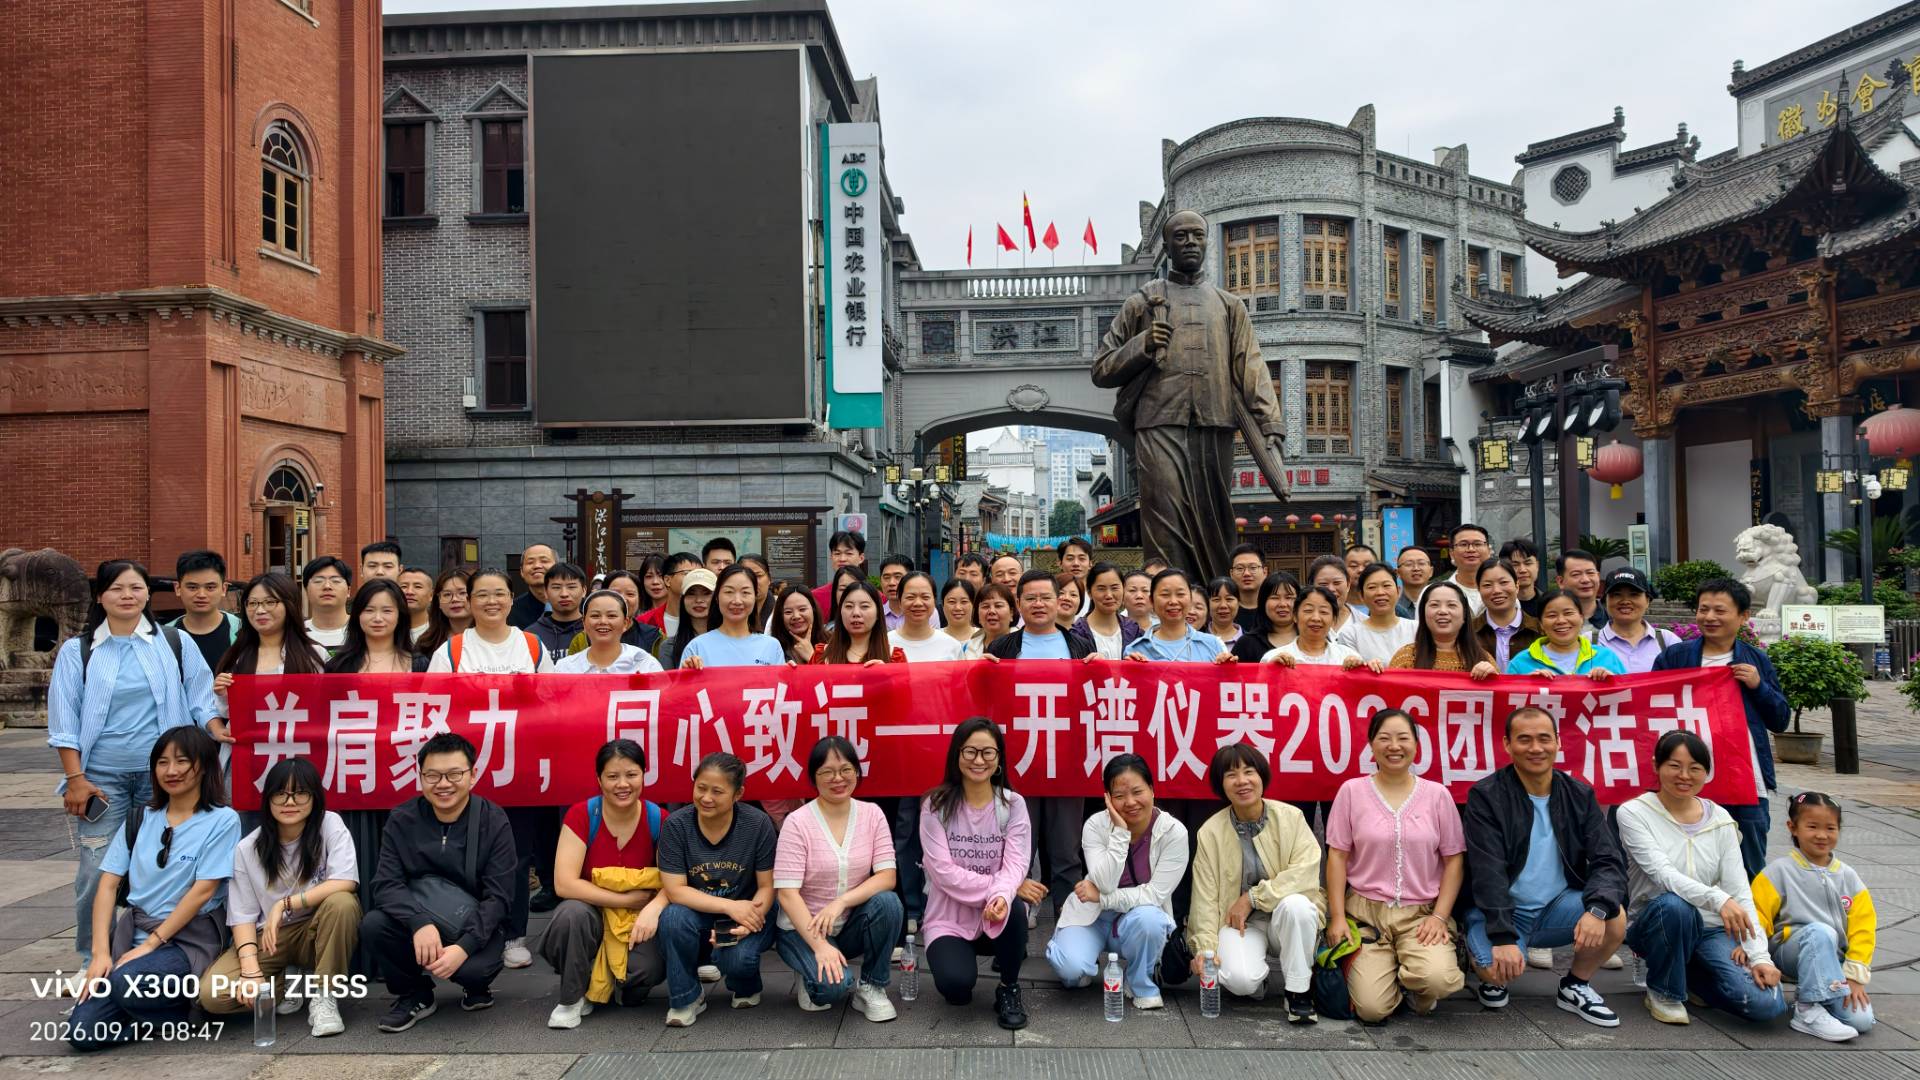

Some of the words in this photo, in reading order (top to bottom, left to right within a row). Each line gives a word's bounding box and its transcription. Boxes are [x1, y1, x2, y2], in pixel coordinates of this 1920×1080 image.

[841, 153, 866, 164] ABC
[843, 202, 867, 347] 中国农业银行
[1790, 622, 1825, 631] 禁止通行
[713, 861, 746, 873] WORRY
